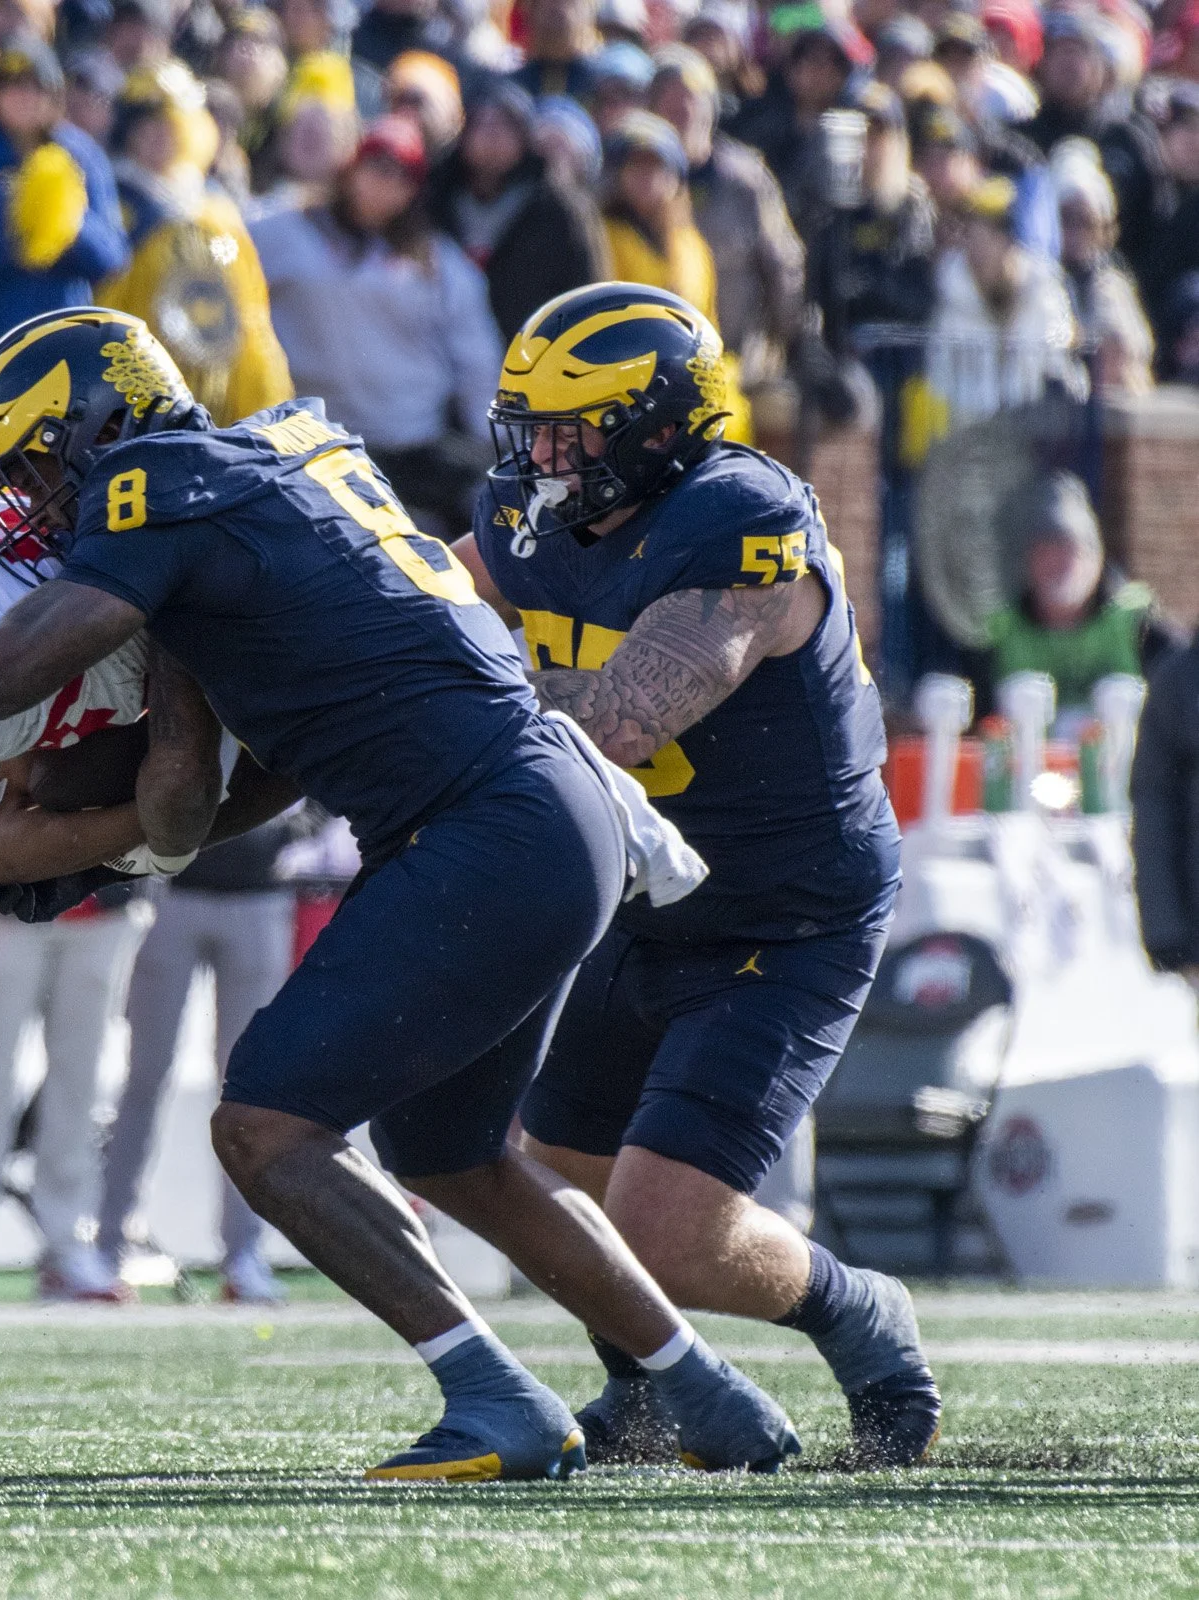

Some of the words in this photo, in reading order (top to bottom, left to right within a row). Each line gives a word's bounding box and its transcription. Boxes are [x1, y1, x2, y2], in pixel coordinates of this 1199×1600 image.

[250, 410, 349, 455] MOOR
[107, 467, 147, 533] 8
[304, 447, 477, 606] 8
[494, 505, 524, 529] BI
[741, 530, 809, 584] 55
